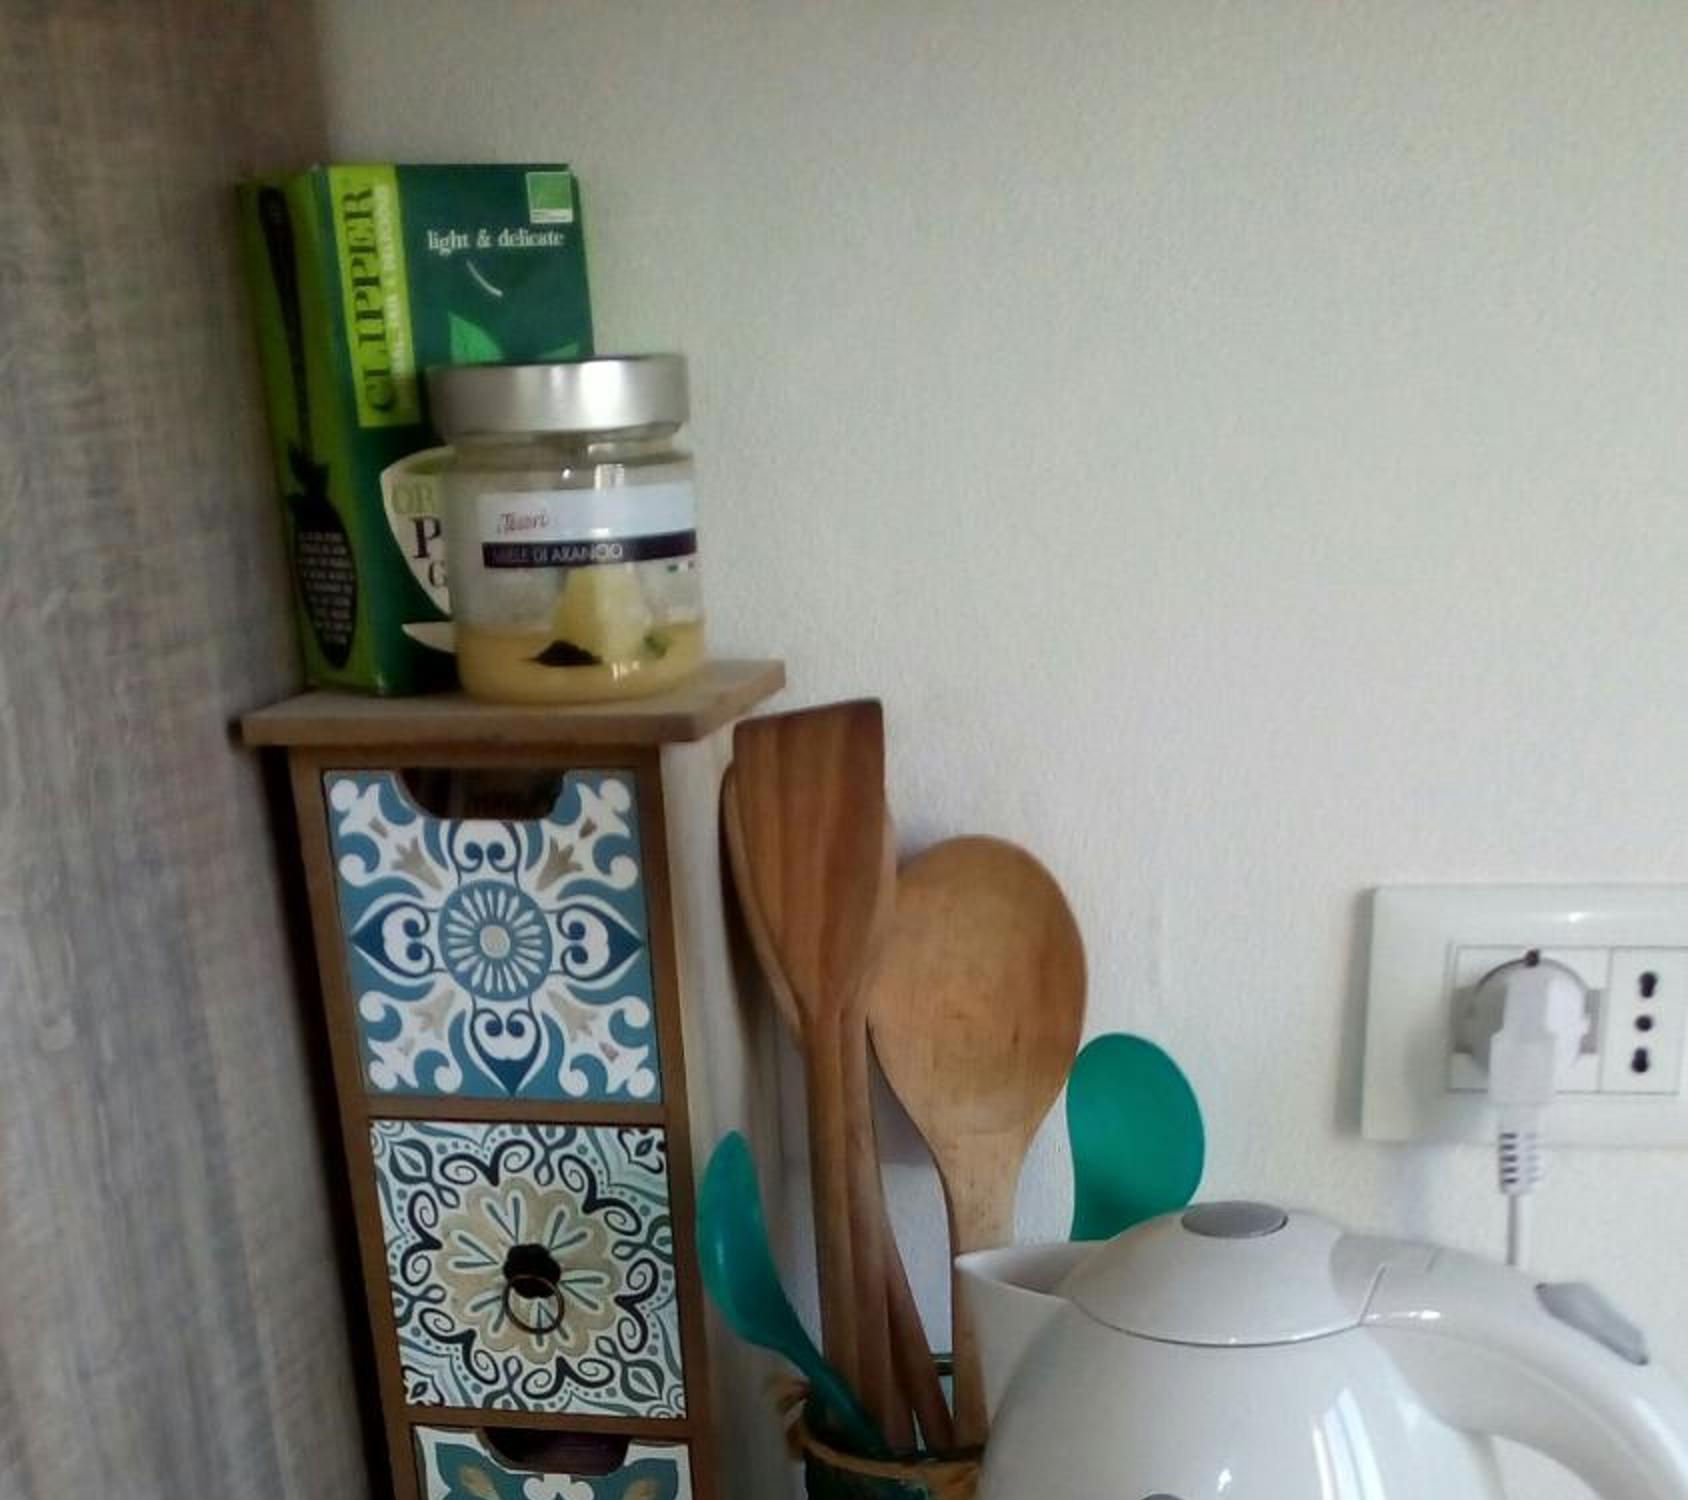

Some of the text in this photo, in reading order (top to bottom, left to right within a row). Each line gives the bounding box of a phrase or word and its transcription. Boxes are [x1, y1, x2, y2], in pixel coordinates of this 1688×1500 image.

[342, 186, 394, 413] CLIPPER
[427, 227, 565, 257] light & delicate
